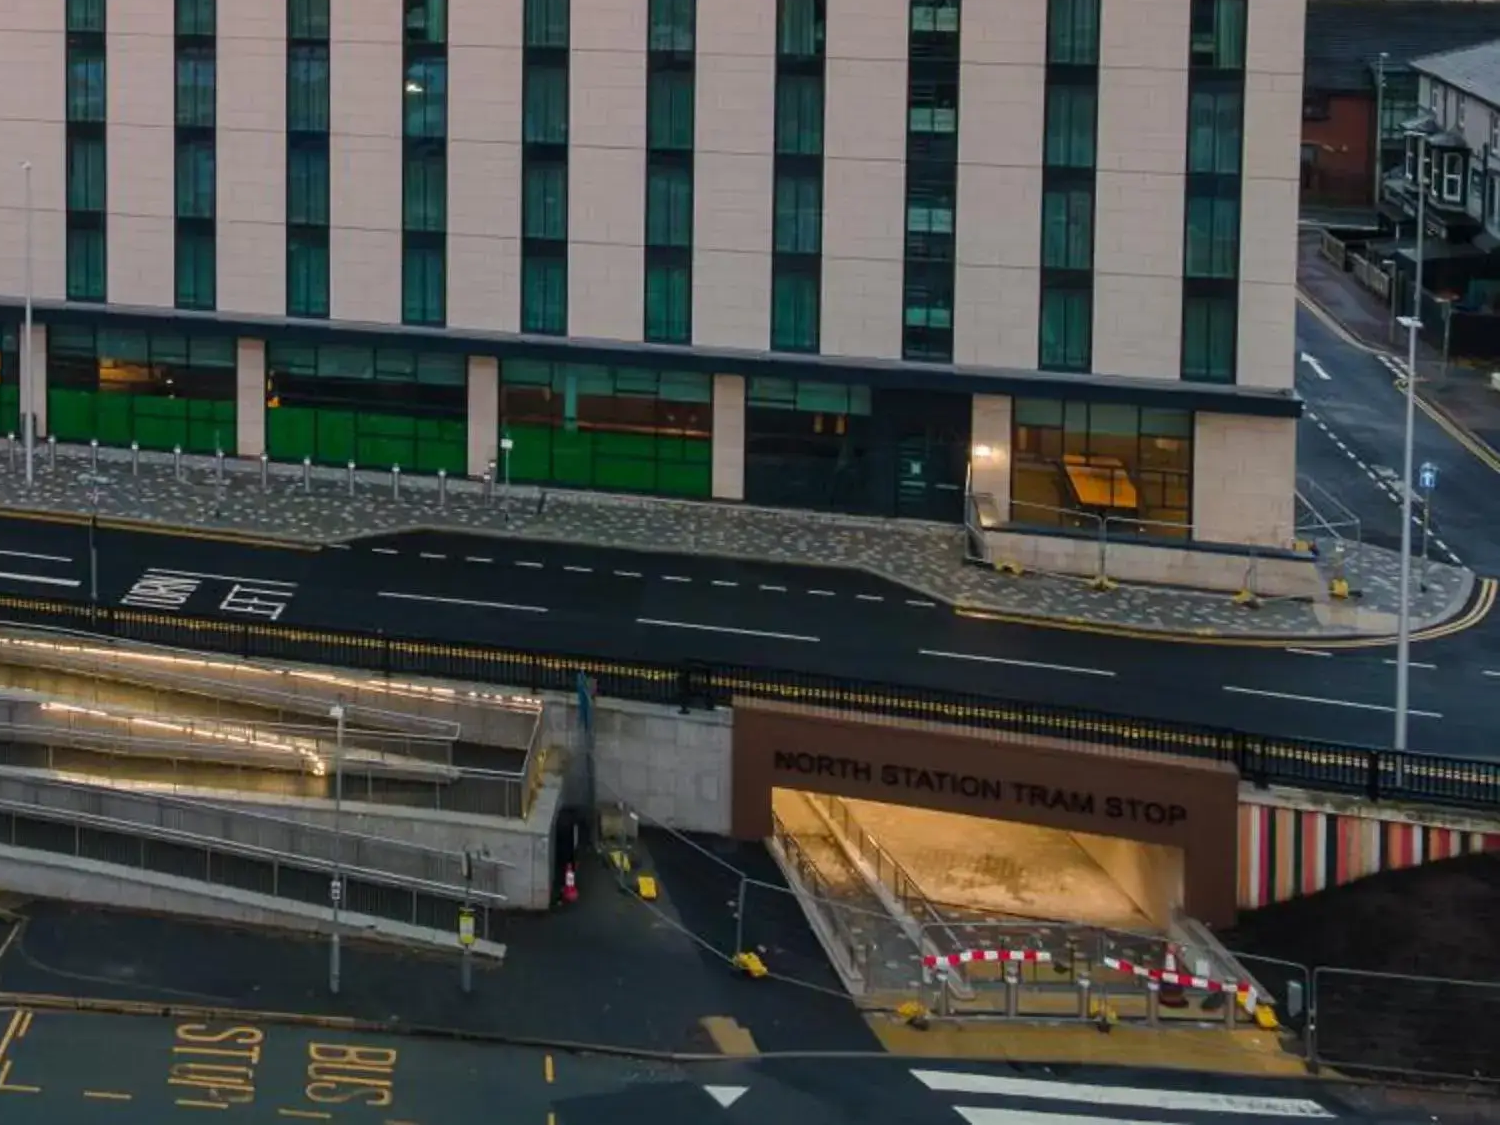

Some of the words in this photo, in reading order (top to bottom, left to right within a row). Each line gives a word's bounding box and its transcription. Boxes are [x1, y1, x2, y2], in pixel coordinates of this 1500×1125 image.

[773, 750, 871, 782] NORTH
[881, 764, 1001, 801] STATION
[1013, 782, 1094, 815] TRAM
[1105, 796, 1187, 826] STOP
[167, 1024, 264, 1104] STOP
[305, 1042, 397, 1105] BUS
